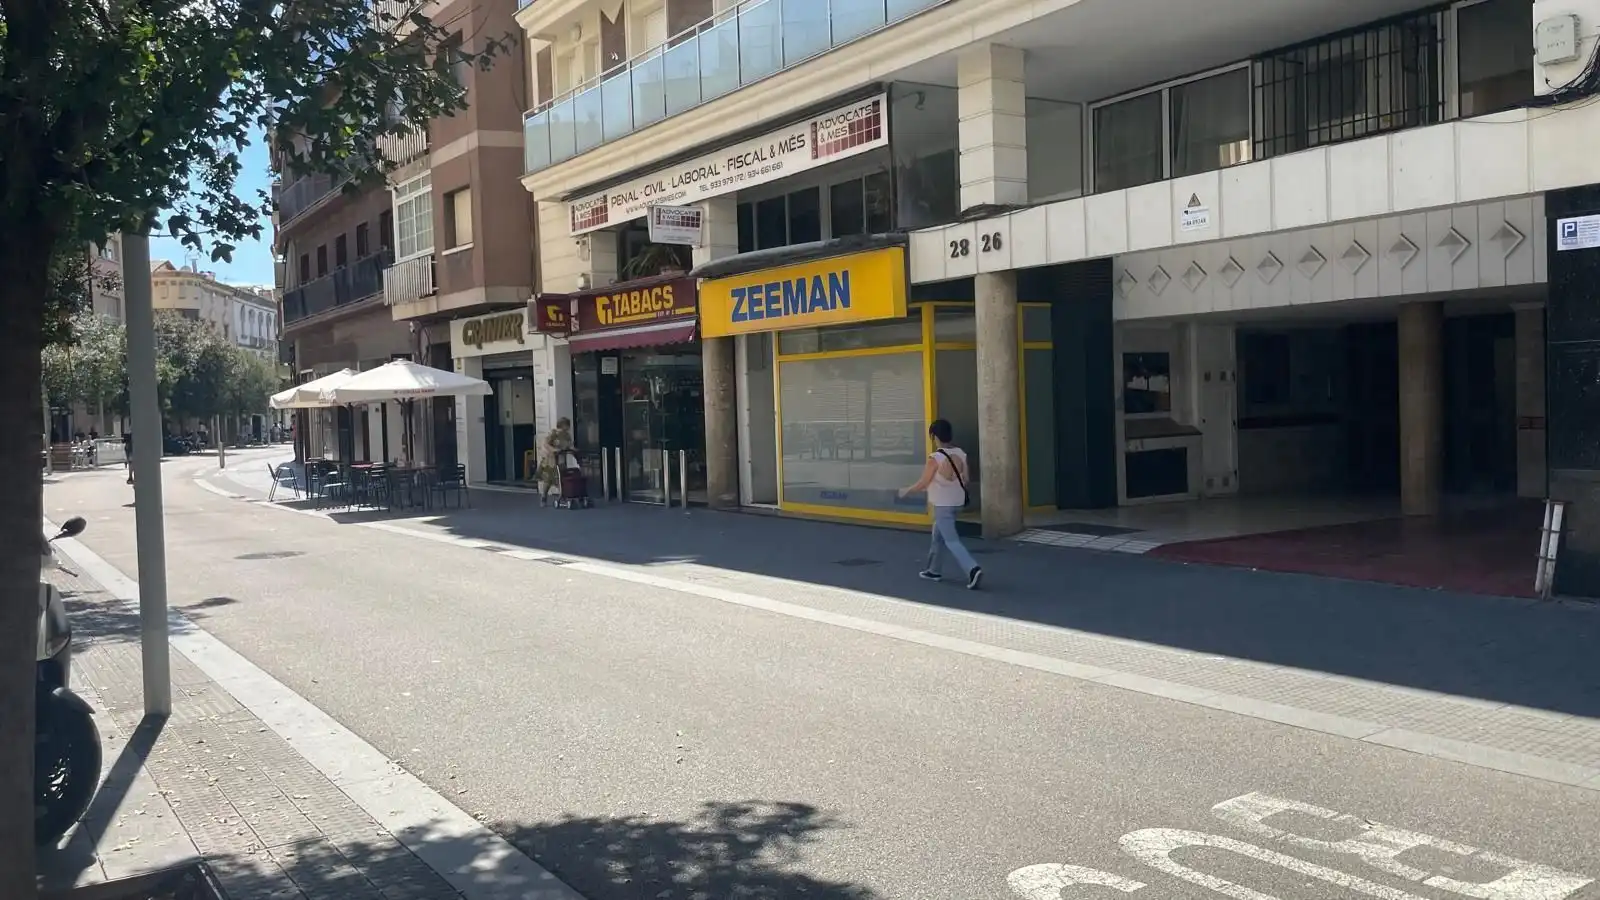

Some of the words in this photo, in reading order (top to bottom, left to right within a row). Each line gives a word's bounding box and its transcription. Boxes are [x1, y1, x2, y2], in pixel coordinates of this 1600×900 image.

[818, 104, 872, 132] ADVOCATS
[611, 190, 638, 208] PENAL
[644, 179, 666, 197] CIVIL
[671, 165, 720, 188] LABORAL
[727, 148, 767, 172] FISCAL
[770, 144, 776, 158] &
[778, 134, 806, 156] MÉS
[981, 232, 1002, 252] 26
[1565, 223, 1575, 237] P
[950, 238, 969, 258] 28
[612, 285, 674, 316] TABACS
[730, 270, 851, 323] ZEEMAN
